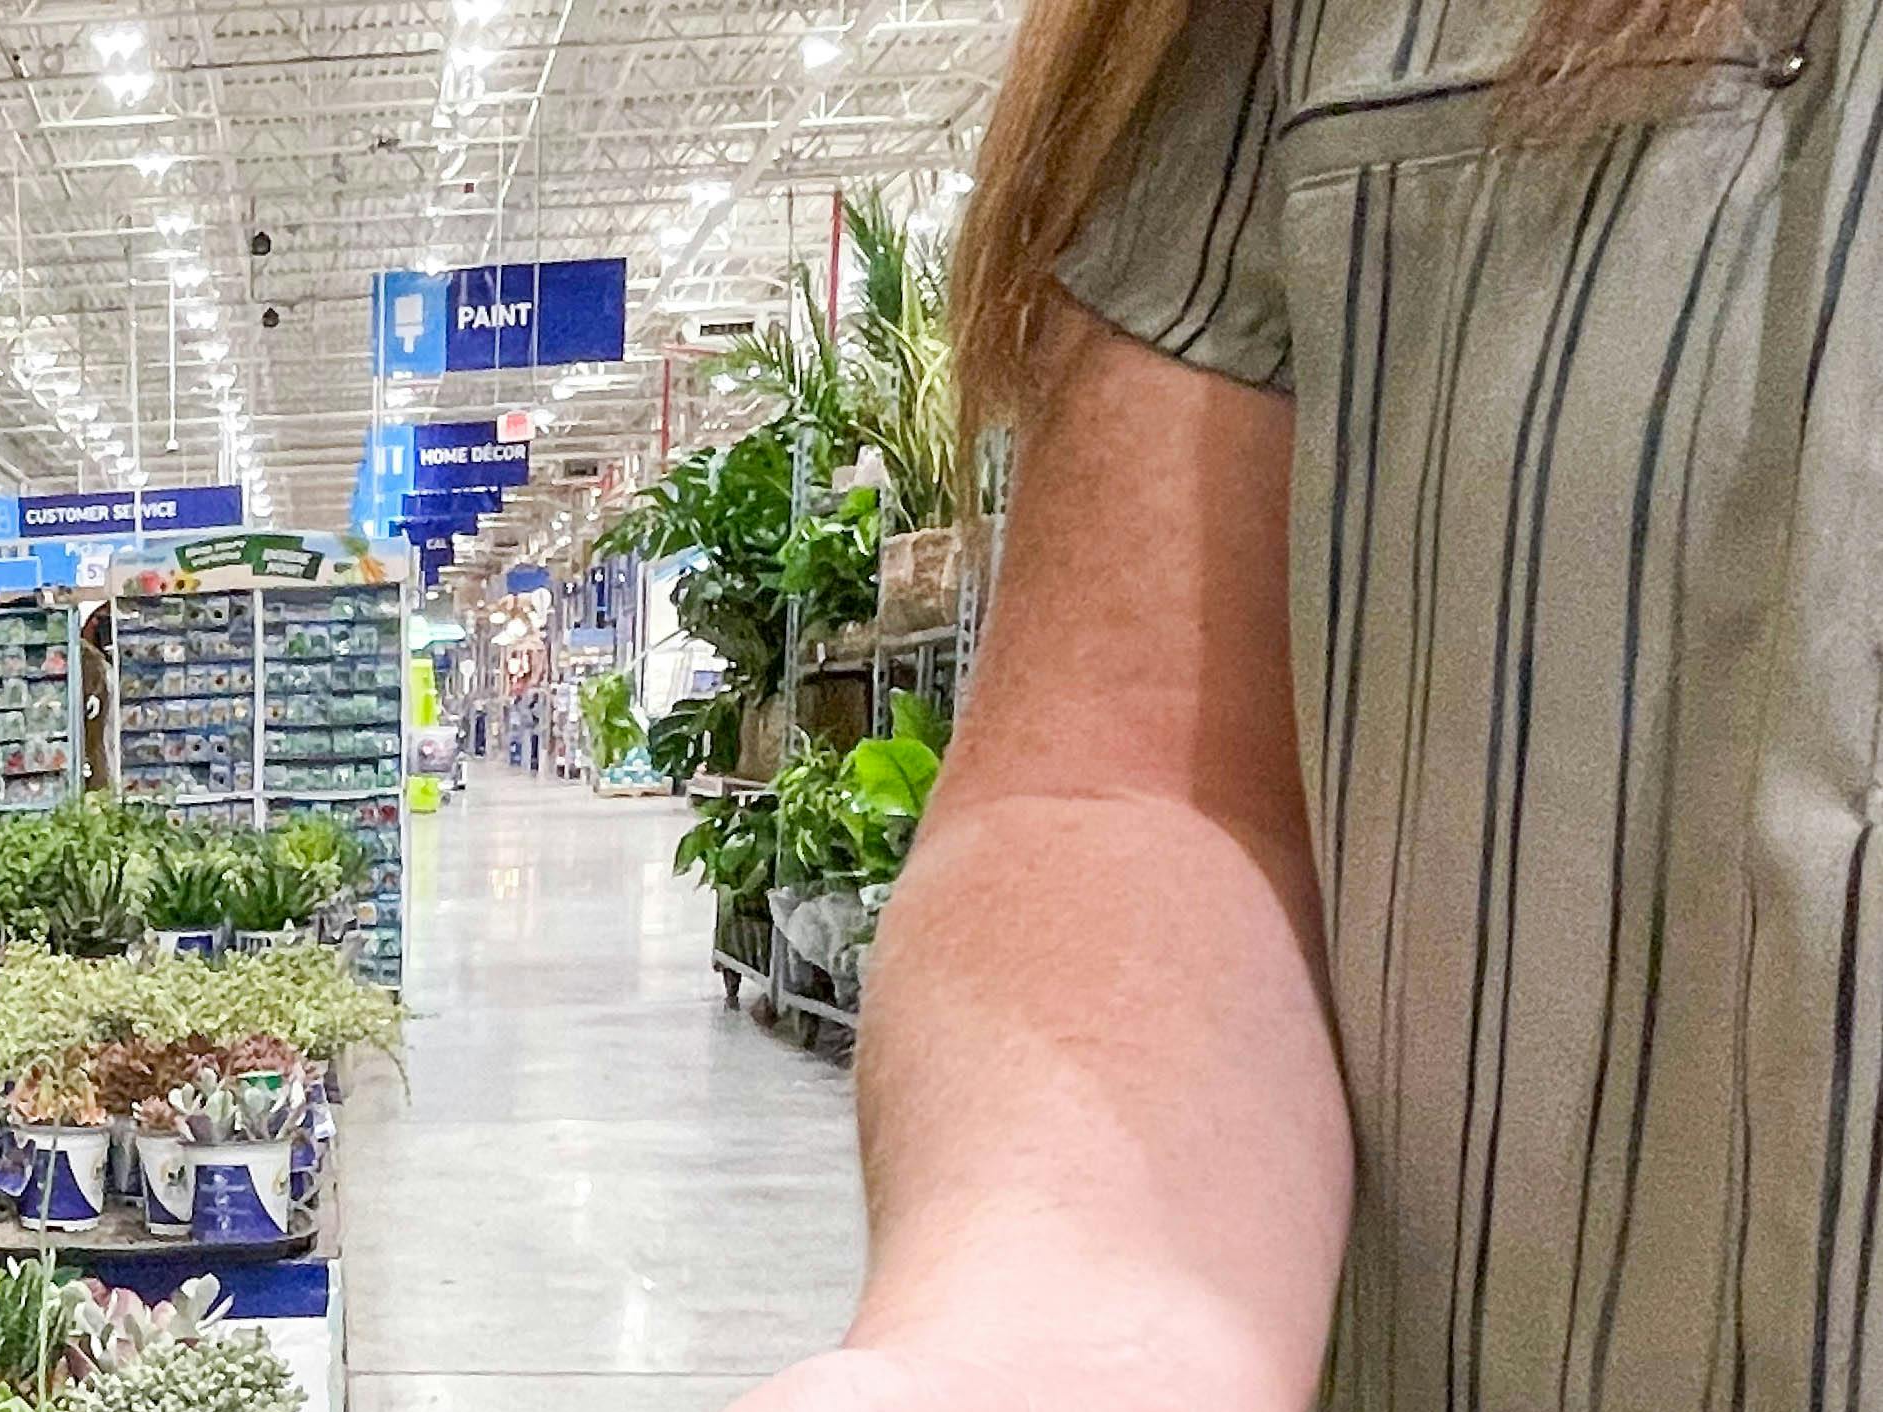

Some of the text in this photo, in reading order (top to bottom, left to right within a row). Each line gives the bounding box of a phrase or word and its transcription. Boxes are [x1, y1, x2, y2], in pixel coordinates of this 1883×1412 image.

[458, 302, 533, 330] PAINT
[420, 442, 526, 466] HOME DÉCOR
[25, 501, 177, 525] CUSTOMER SEVICE
[88, 564, 97, 579] 5
